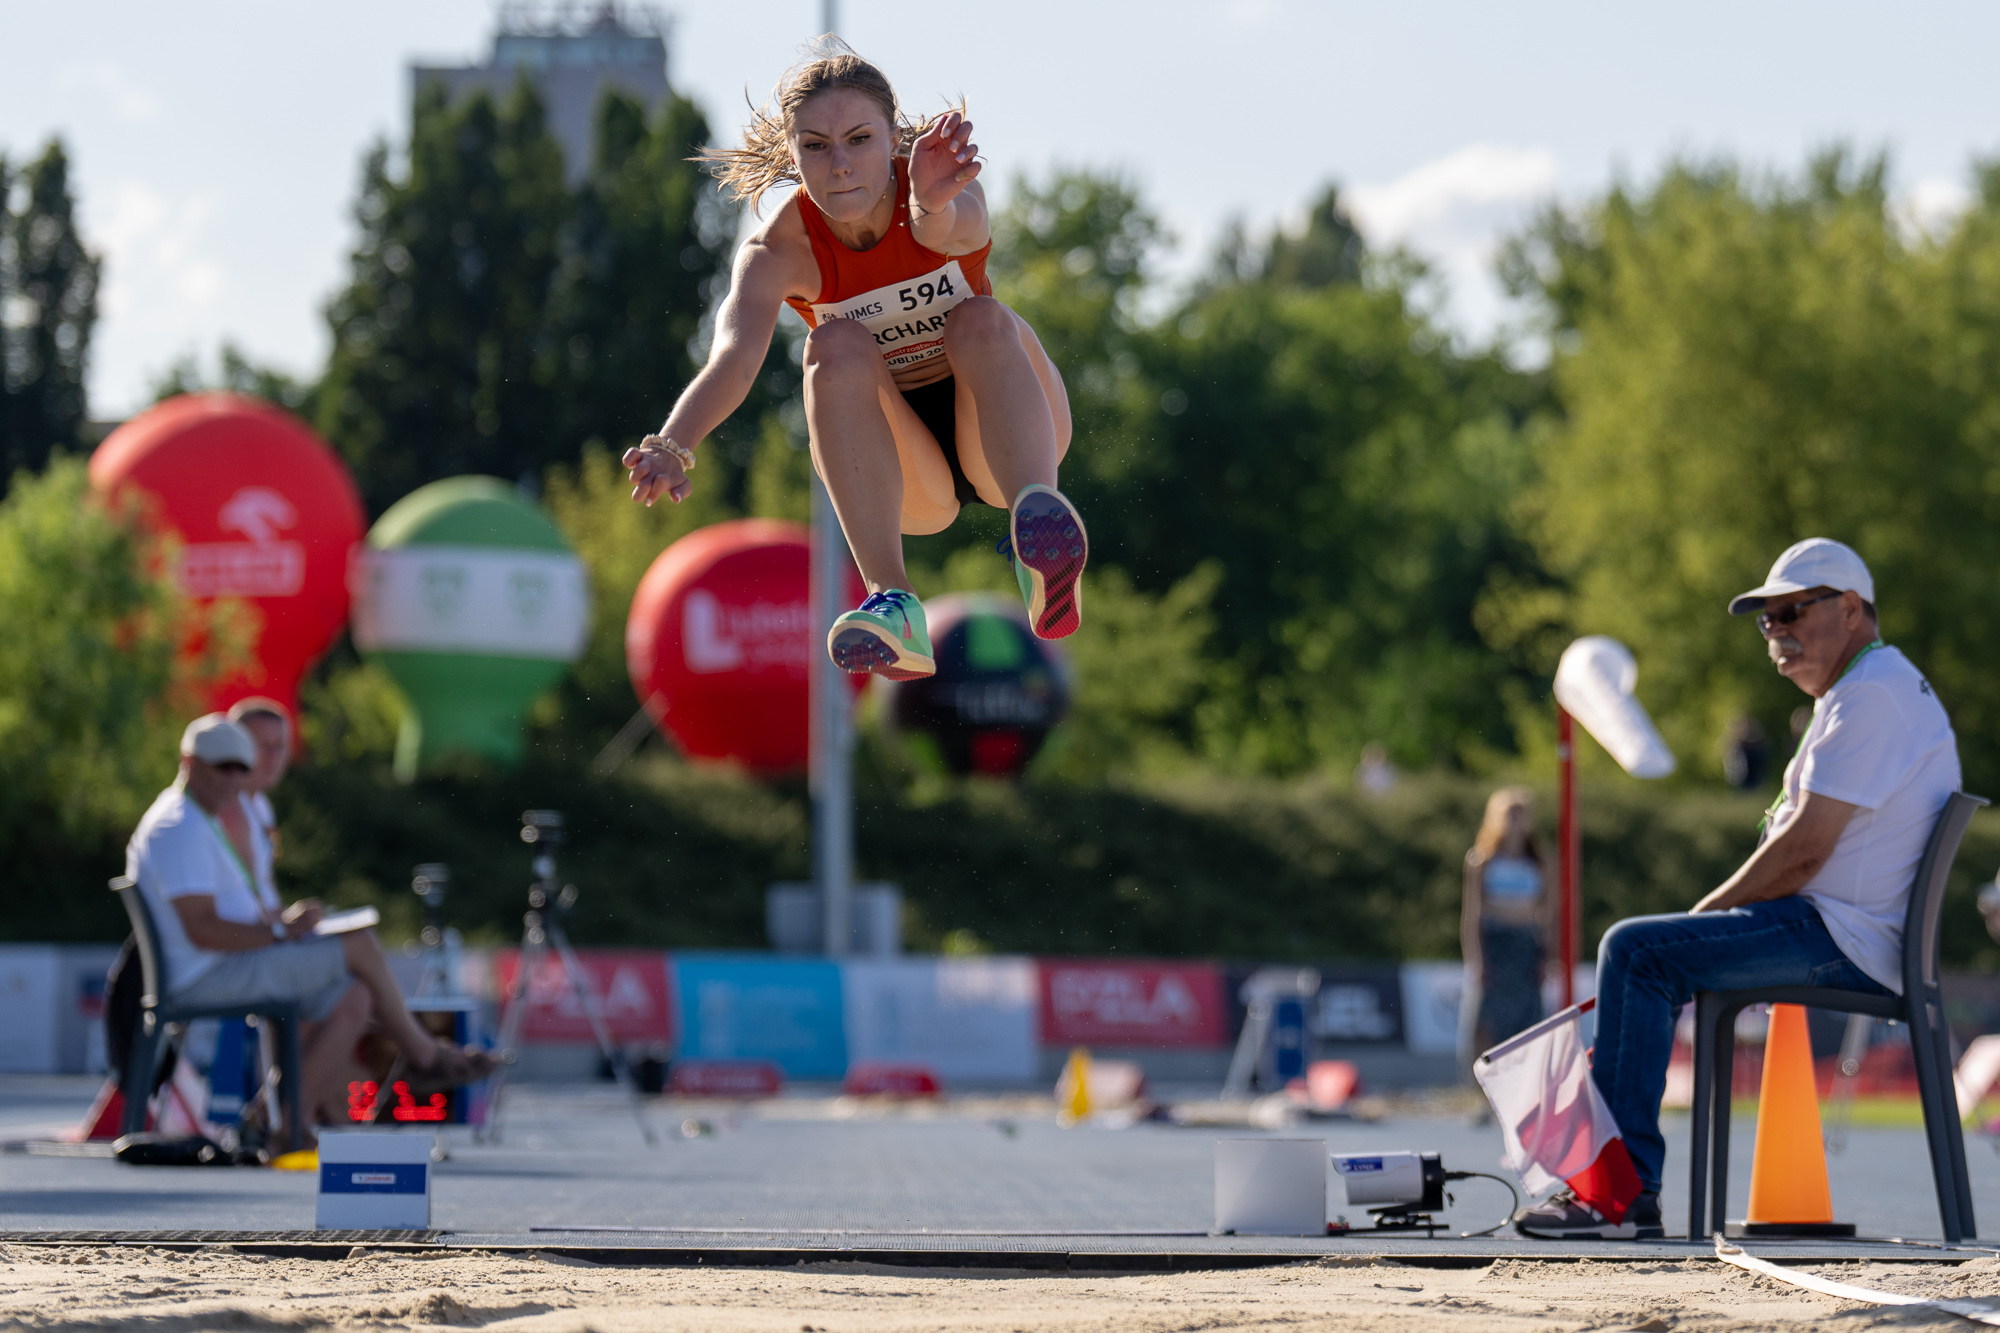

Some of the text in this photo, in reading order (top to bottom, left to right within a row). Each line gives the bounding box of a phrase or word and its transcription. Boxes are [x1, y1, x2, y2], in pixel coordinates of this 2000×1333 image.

[898, 273, 954, 311] 594
[845, 302, 883, 320] UMCS
[886, 353, 924, 367] UBLIN
